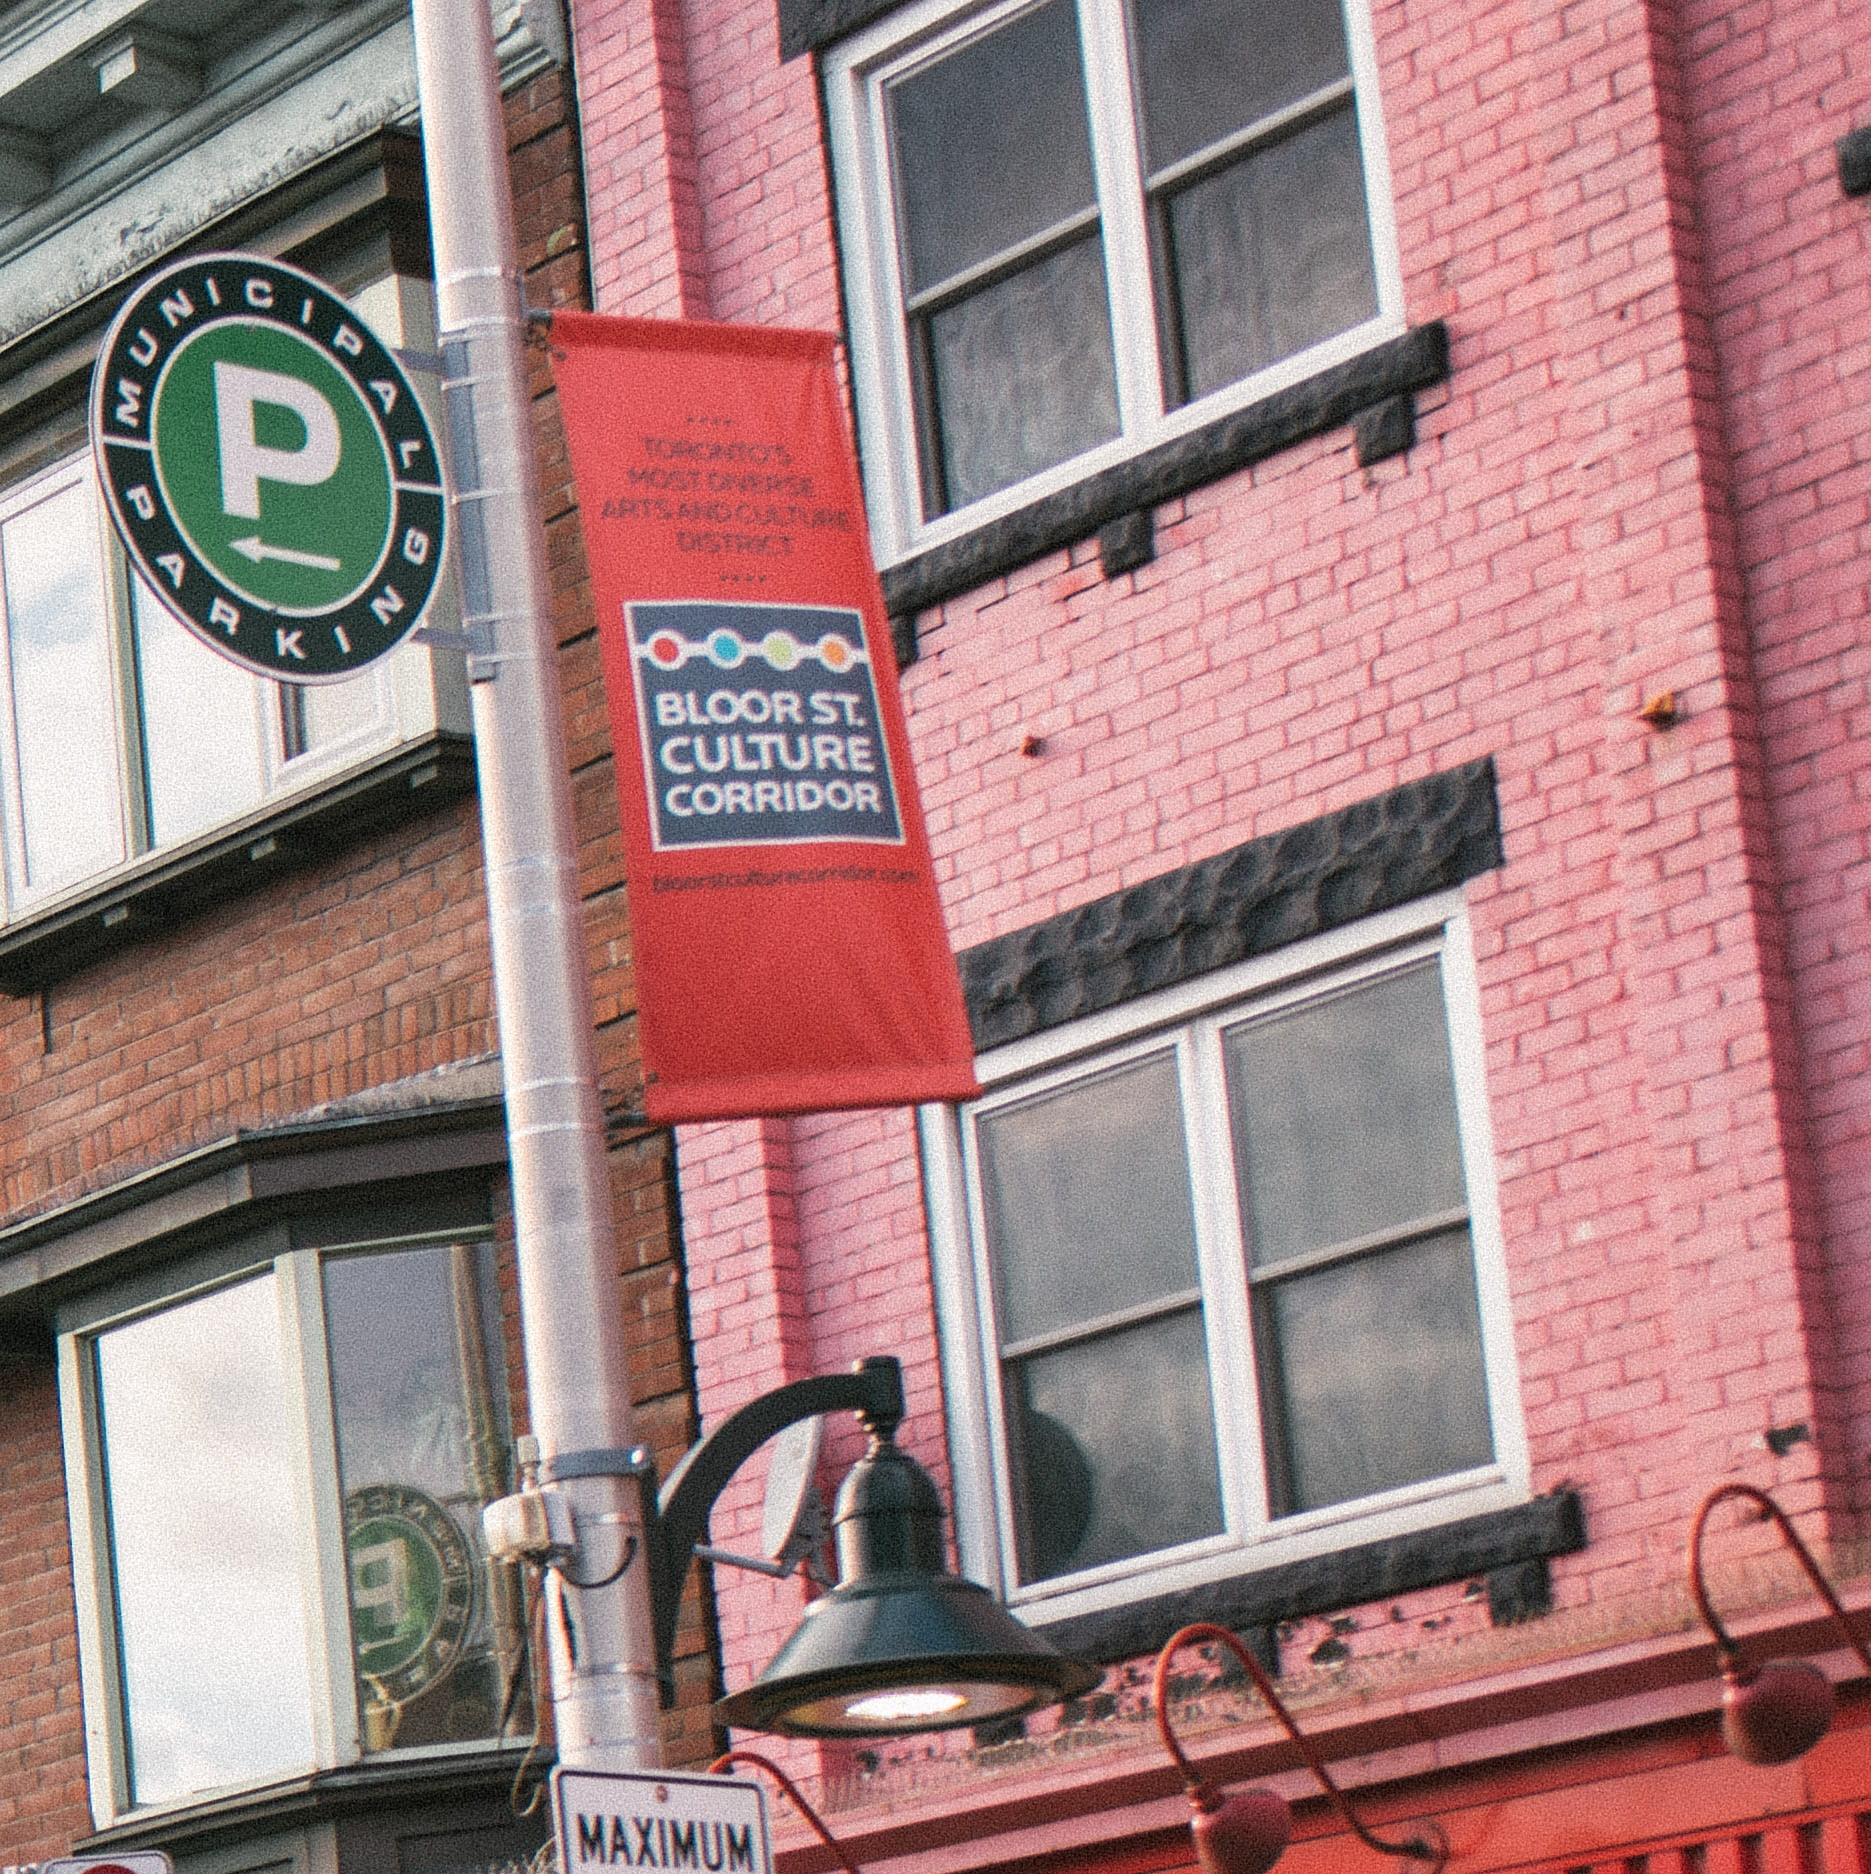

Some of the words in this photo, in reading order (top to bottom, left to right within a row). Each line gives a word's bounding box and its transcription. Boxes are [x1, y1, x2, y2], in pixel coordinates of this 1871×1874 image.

[115, 277, 422, 469] MUNICIPAL
[213, 360, 343, 520] P
[643, 437, 792, 466] TORONTO'S
[627, 467, 701, 491] MOST
[705, 472, 817, 498] DIVERSE
[601, 497, 673, 520] ARTS
[677, 501, 732, 523] AND
[734, 504, 853, 532] CULTURE
[675, 531, 794, 556] DISTRICT
[125, 485, 430, 660] PARKING
[656, 691, 802, 726] BLOOR
[809, 694, 866, 727] ST.
[660, 733, 875, 775] CULTURE
[664, 780, 882, 817] CORRIDOR
[577, 1813, 755, 1873] MAXIMUM
